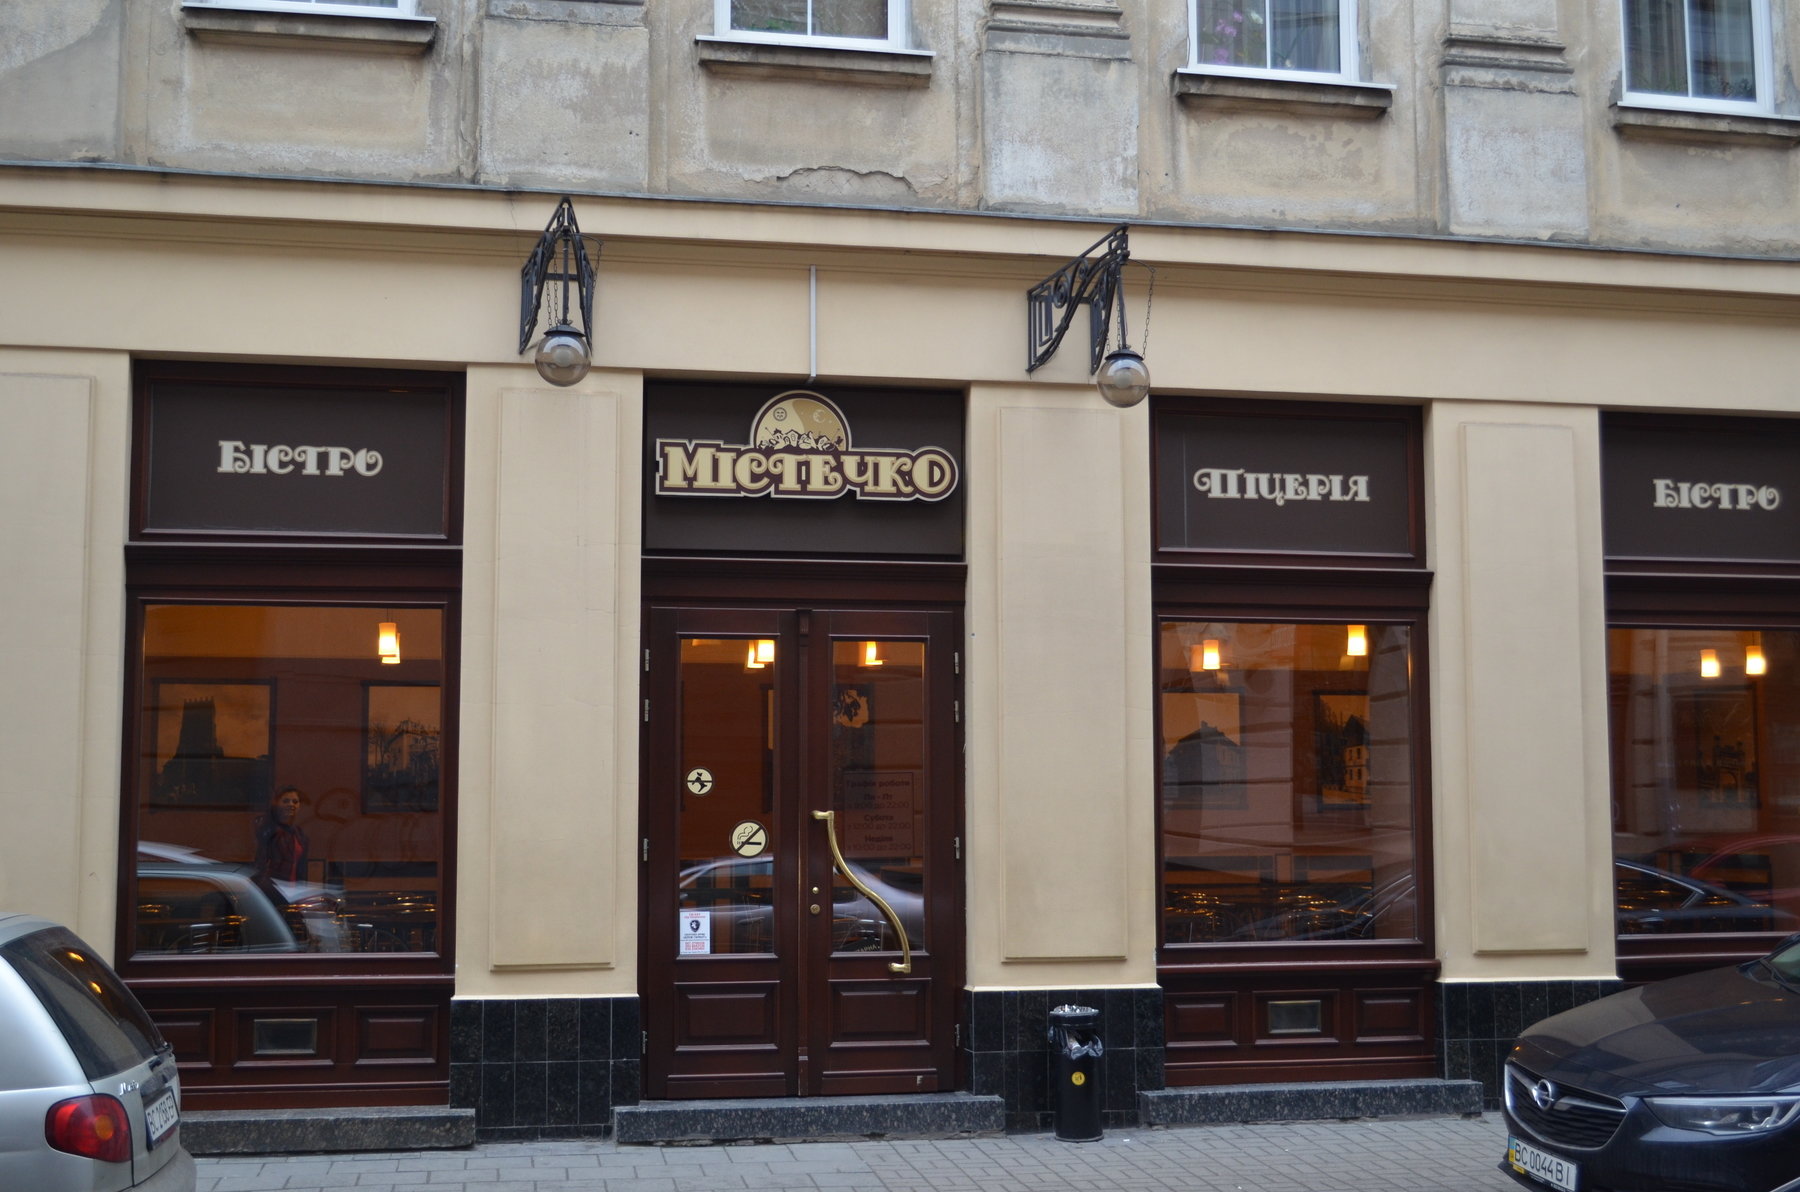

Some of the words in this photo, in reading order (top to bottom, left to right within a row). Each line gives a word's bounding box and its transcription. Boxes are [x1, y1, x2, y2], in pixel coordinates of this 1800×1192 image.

[217, 440, 383, 477] БІСТРО
[663, 446, 951, 494] МІСТЕЧКО
[1193, 468, 1370, 506] ПІЦЕРІЯ
[1653, 479, 1780, 511] БІСТРО
[1515, 1143, 1527, 1166] BC
[1530, 1151, 1553, 1178] 0044
[1556, 1162, 1570, 1186] BI
